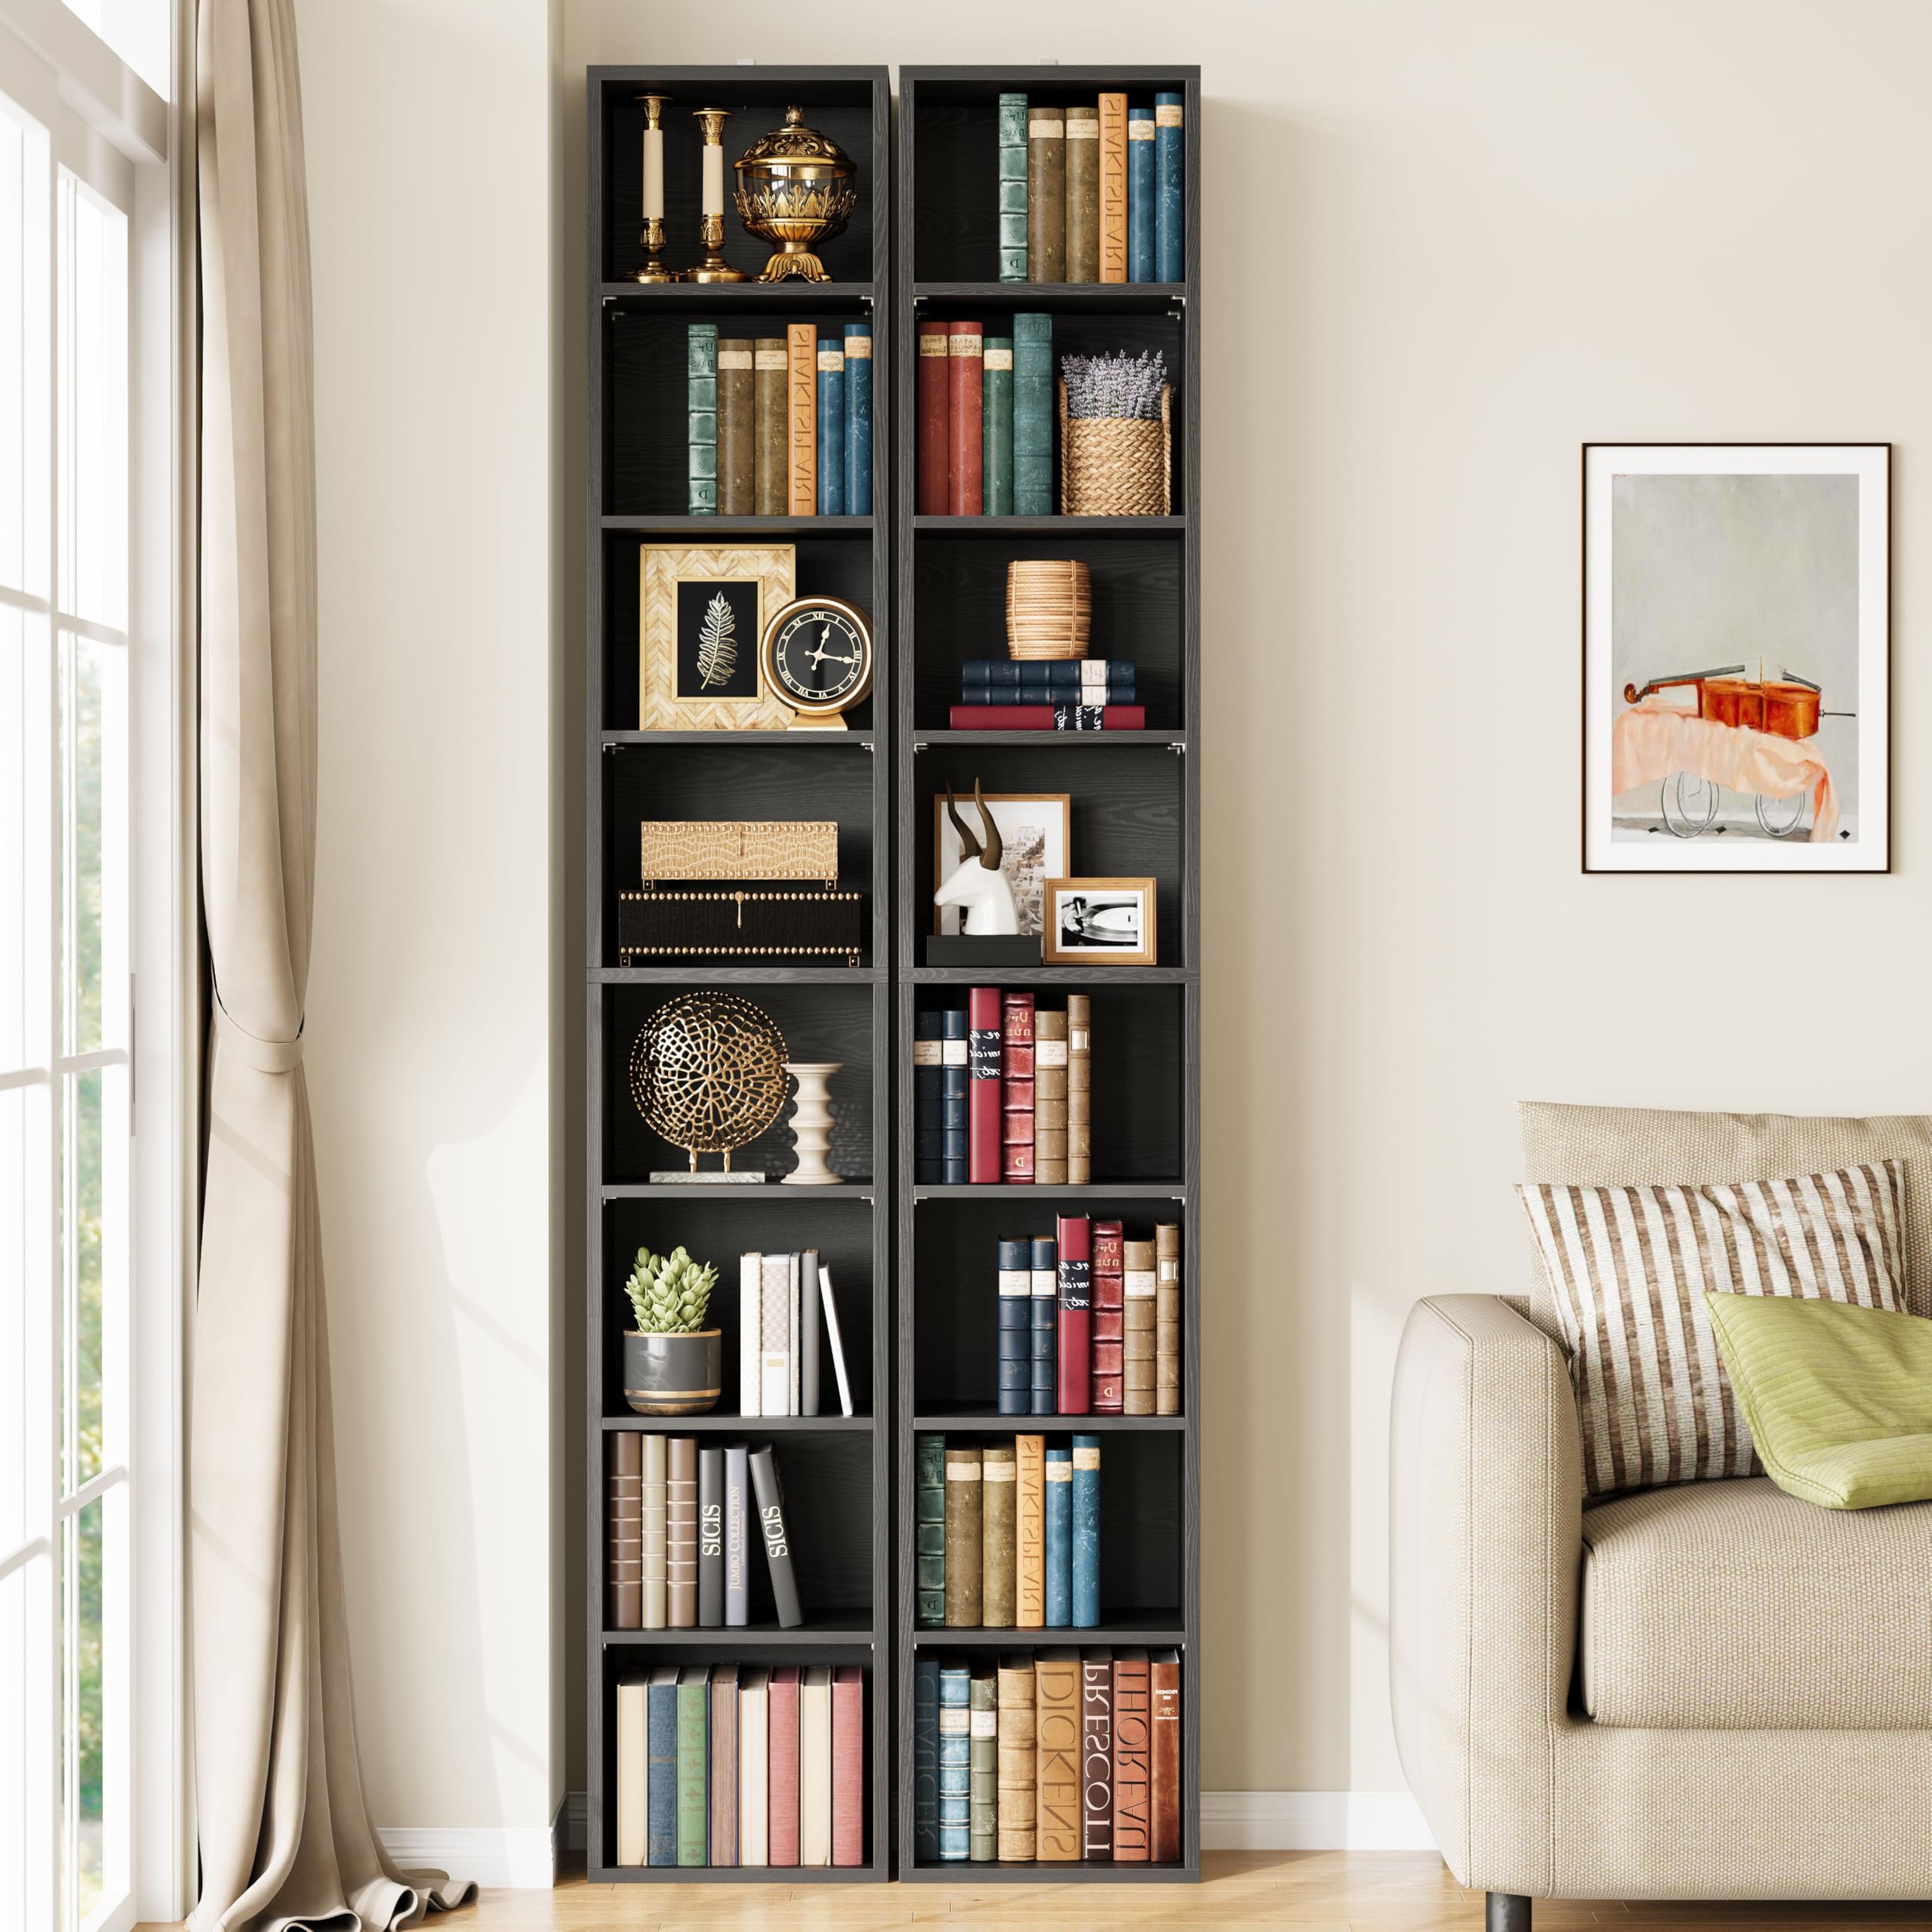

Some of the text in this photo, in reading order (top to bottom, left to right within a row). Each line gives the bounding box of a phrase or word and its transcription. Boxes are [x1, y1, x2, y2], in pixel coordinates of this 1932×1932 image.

[792, 619, 801, 629] XI
[849, 631, 857, 639] II
[702, 1504, 721, 1556] SICIS
[728, 1486, 743, 1591] JUMBO COLLECTION
[761, 1505, 788, 1558] SICIS
